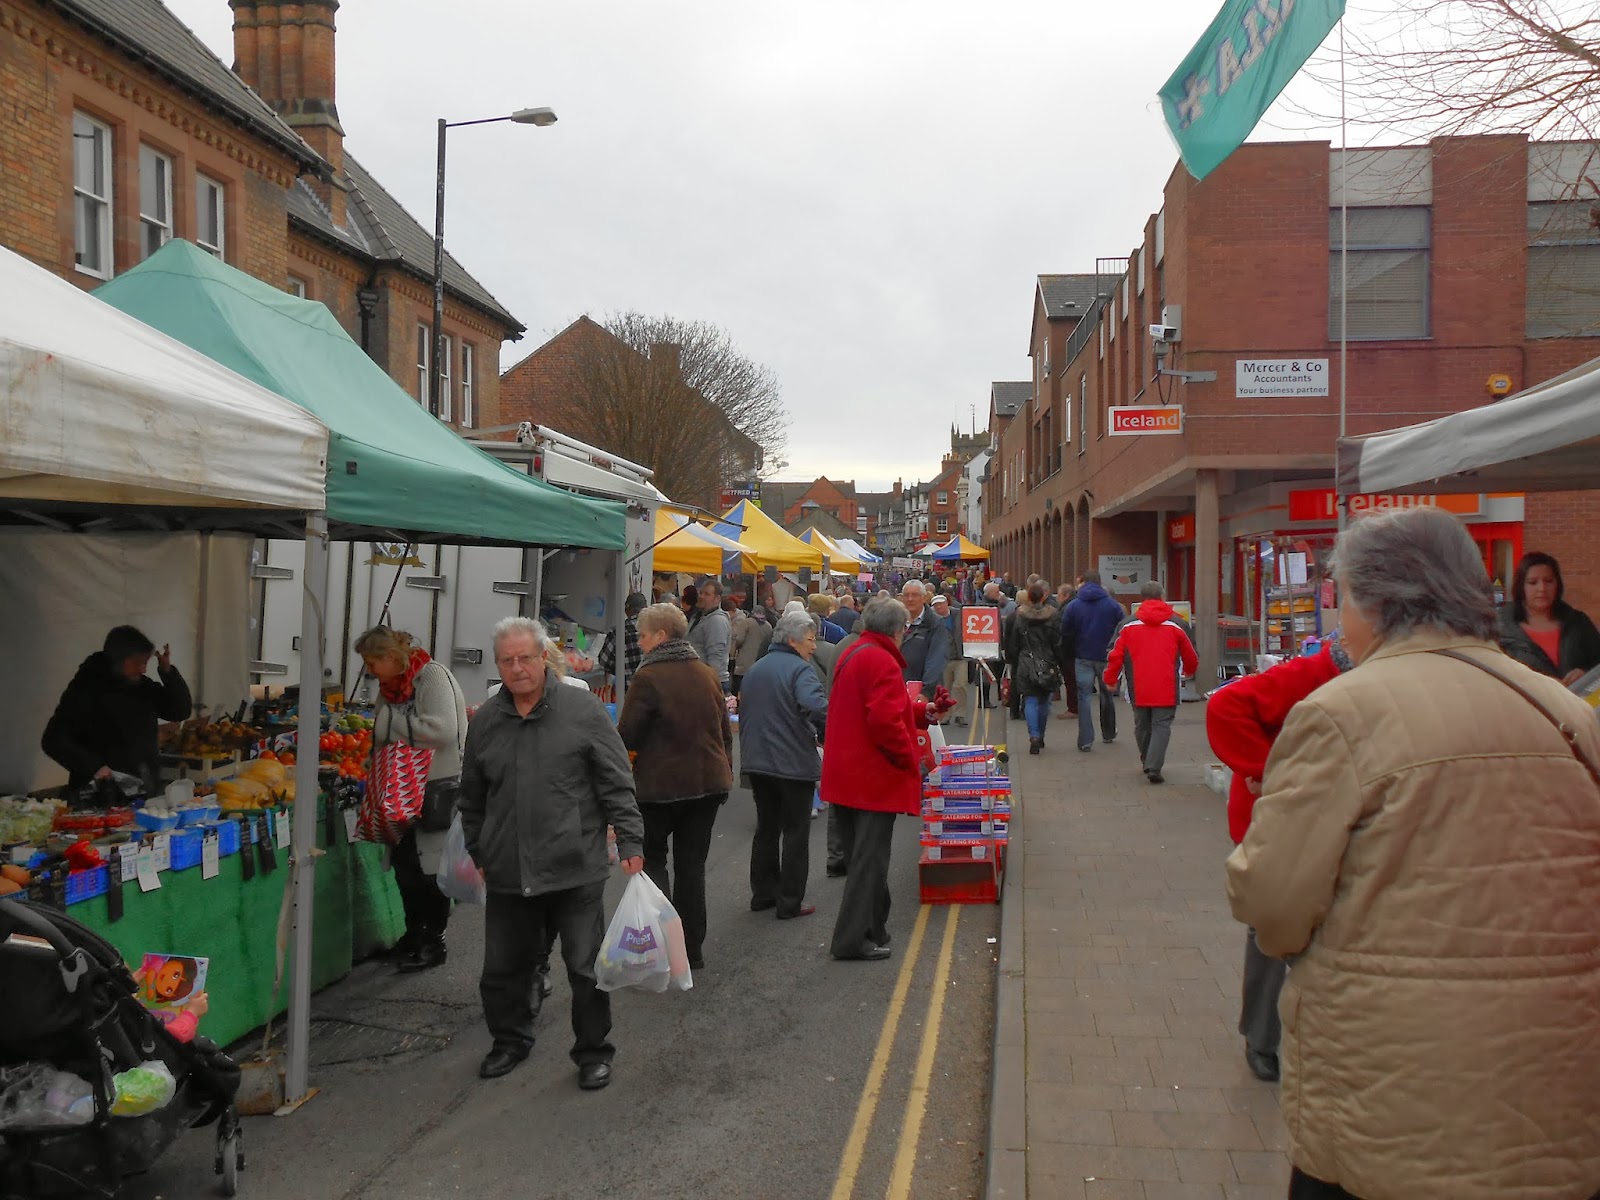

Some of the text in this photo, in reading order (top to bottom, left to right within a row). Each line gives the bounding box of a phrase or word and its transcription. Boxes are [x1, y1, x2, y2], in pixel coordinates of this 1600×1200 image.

[1243, 361, 1322, 373] Mercer & Co
[1253, 375, 1312, 383] Accountants
[1296, 387, 1327, 395] partner
[1116, 413, 1178, 428] Iceland
[911, 559, 922, 568] £8
[966, 614, 994, 635] £2
